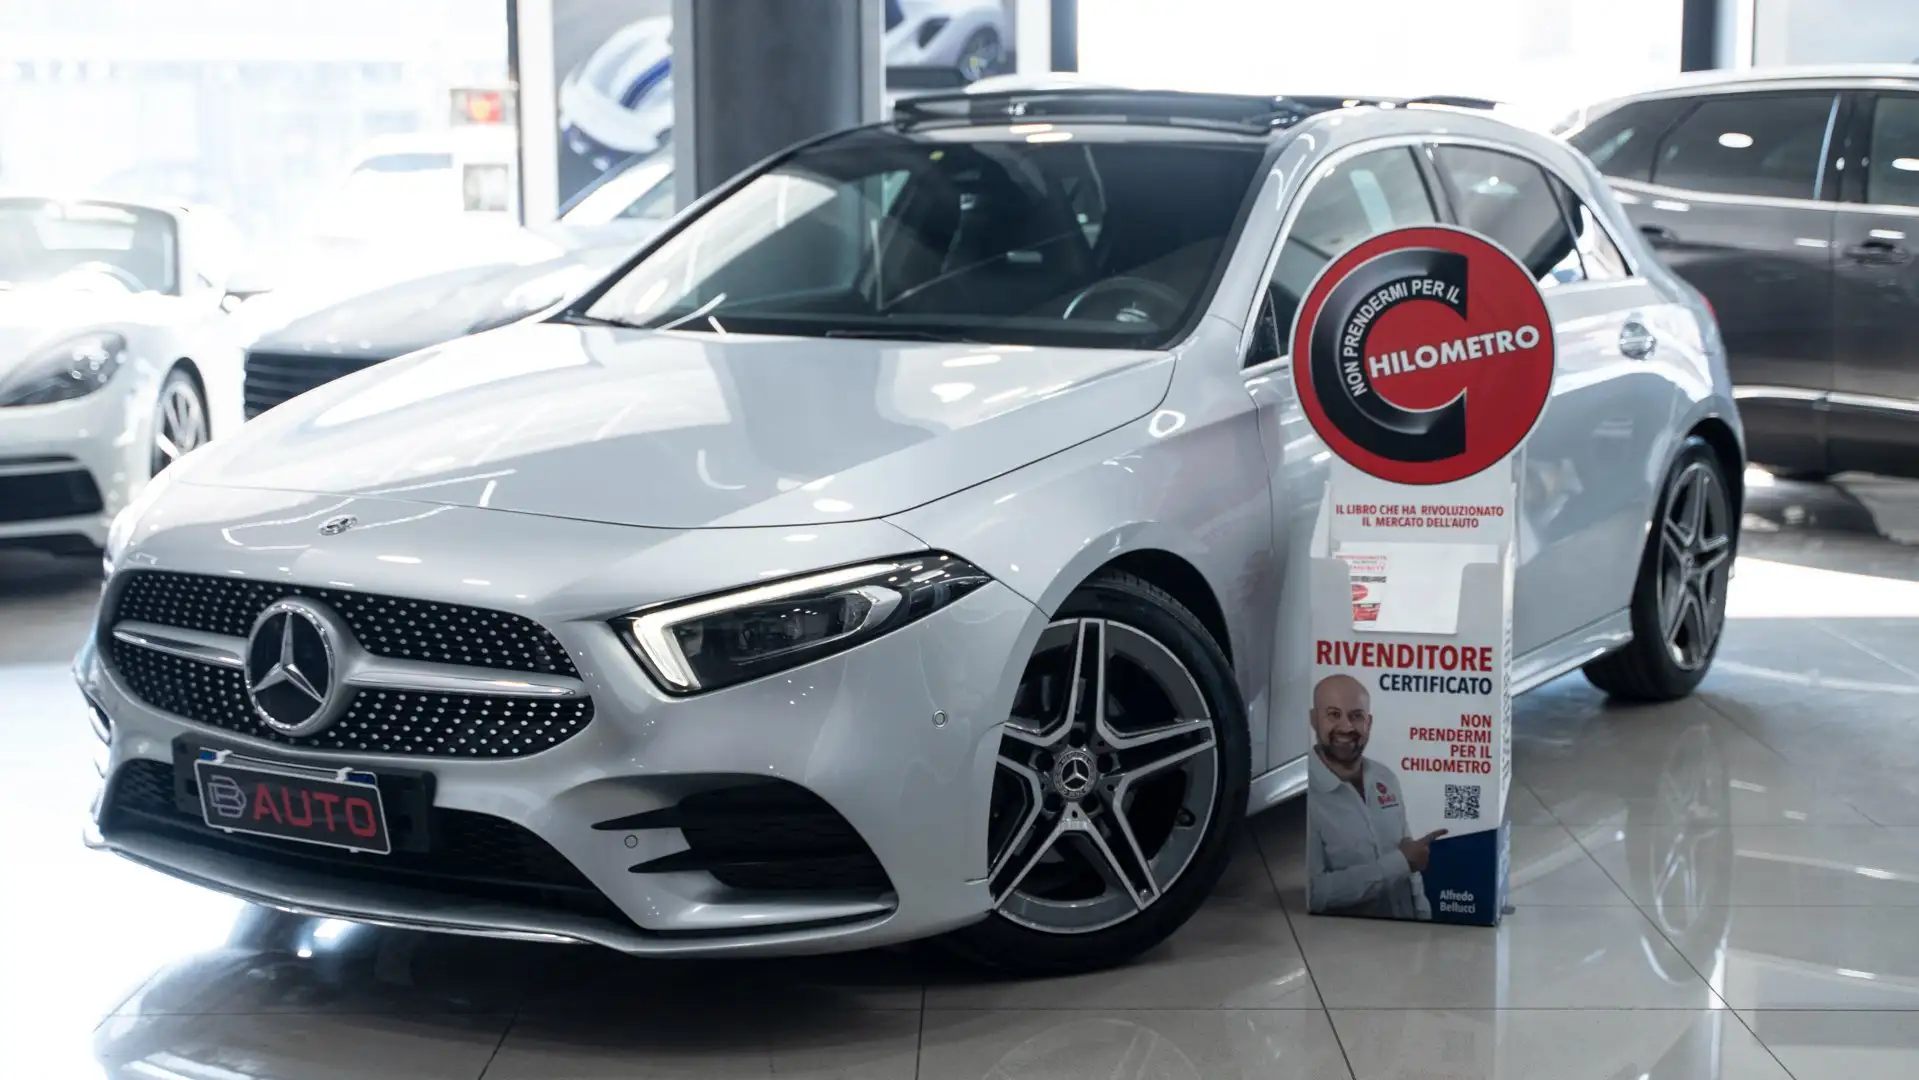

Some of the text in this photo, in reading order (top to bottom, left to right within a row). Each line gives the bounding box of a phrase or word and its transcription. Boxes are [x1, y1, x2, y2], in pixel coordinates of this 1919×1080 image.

[1343, 279, 1461, 397] NON PRENDERMI PER IL
[1336, 504, 1504, 517] IL LIBRO CHE HA RIVOLUZIONATO
[1362, 517, 1479, 528] IL MERCATO DELL'AUTO
[1316, 640, 1493, 672] RIVENDITORE
[1379, 673, 1493, 695] CERTIFICATO
[1460, 714, 1492, 728] NON
[1409, 727, 1492, 743] PRENDERMI
[1450, 744, 1492, 758] PER IL
[1401, 757, 1492, 774] CHILOMETRO
[253, 783, 377, 837] AUTO
[1439, 889, 1474, 902] Alfredo
[1439, 902, 1476, 914] Bellucci
